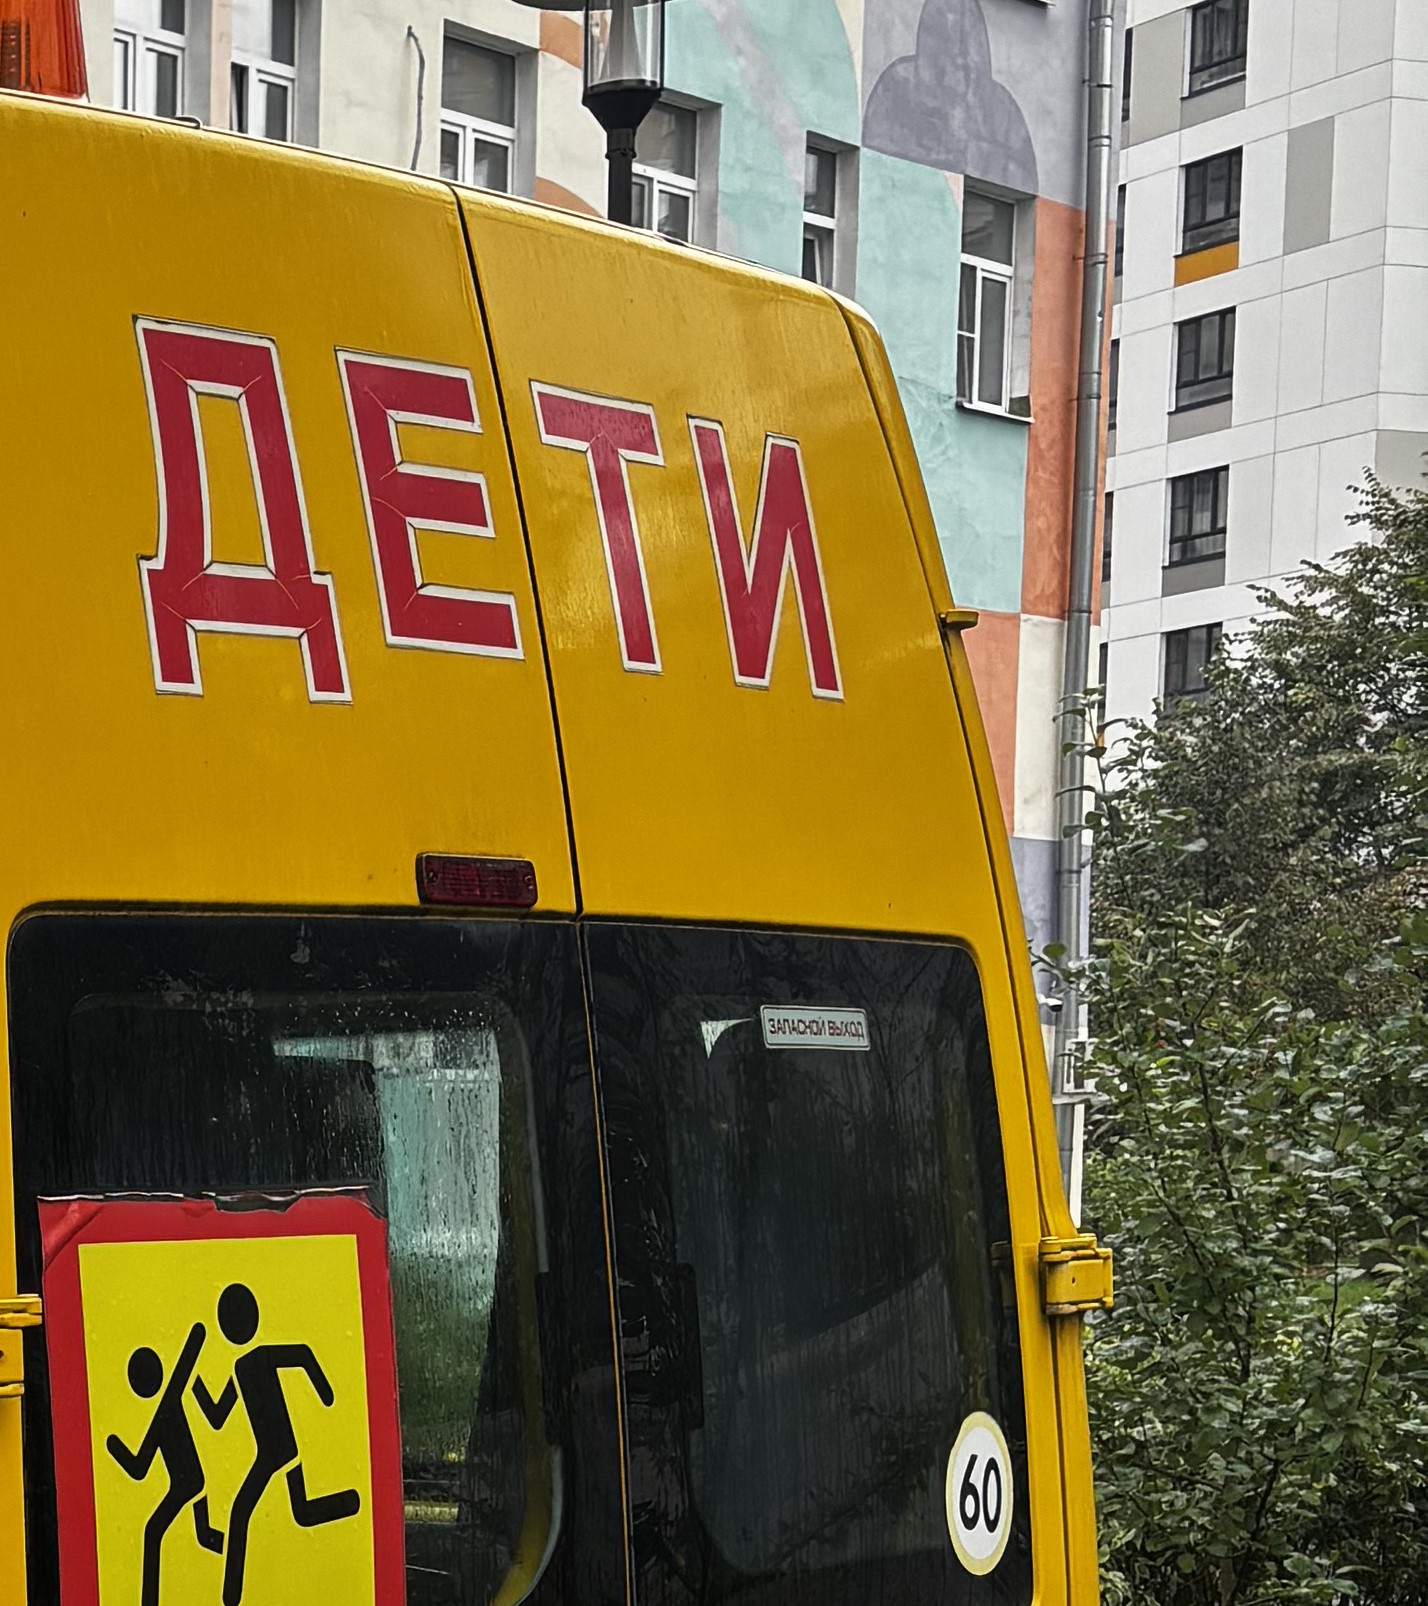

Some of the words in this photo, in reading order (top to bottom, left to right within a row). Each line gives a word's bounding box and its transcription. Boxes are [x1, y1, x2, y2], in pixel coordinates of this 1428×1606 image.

[132, 315, 844, 704] ДЕТИ
[768, 1016, 826, 1036] ЗАПАСНОЙ
[828, 1020, 864, 1041] ВЫХОД
[959, 1453, 1002, 1533] 60
